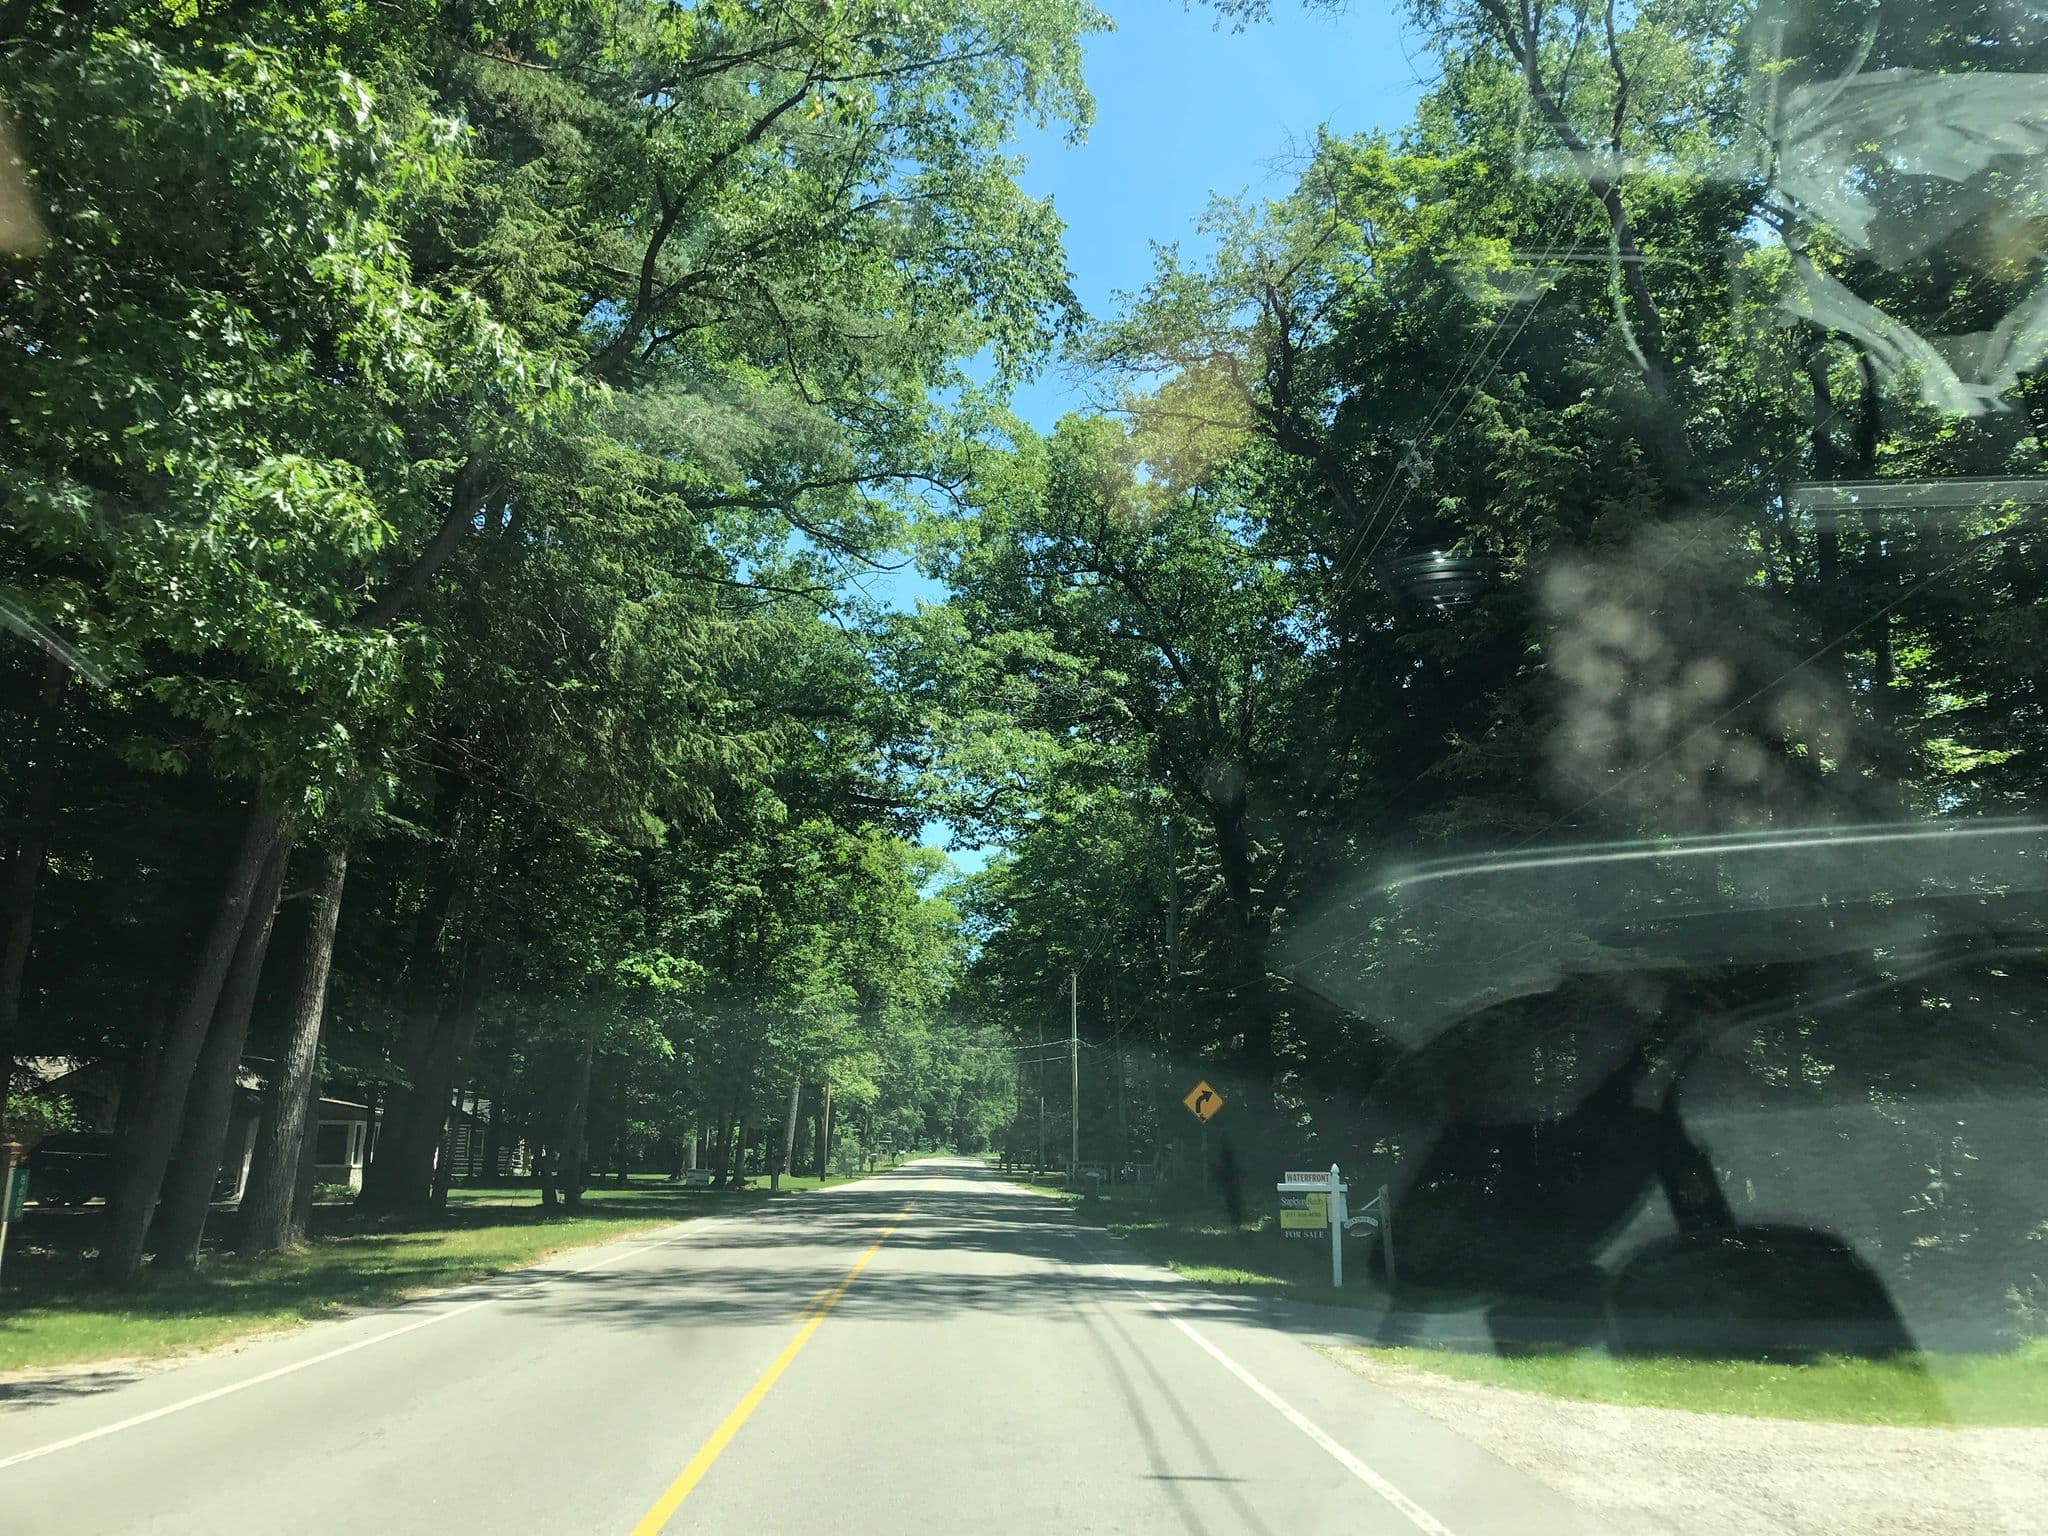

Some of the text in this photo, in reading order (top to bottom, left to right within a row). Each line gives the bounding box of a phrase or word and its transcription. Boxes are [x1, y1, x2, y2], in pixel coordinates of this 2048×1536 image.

[1286, 1173, 1329, 1183] WATERFRONT
[1285, 1231, 1324, 1239] FOR SALE
